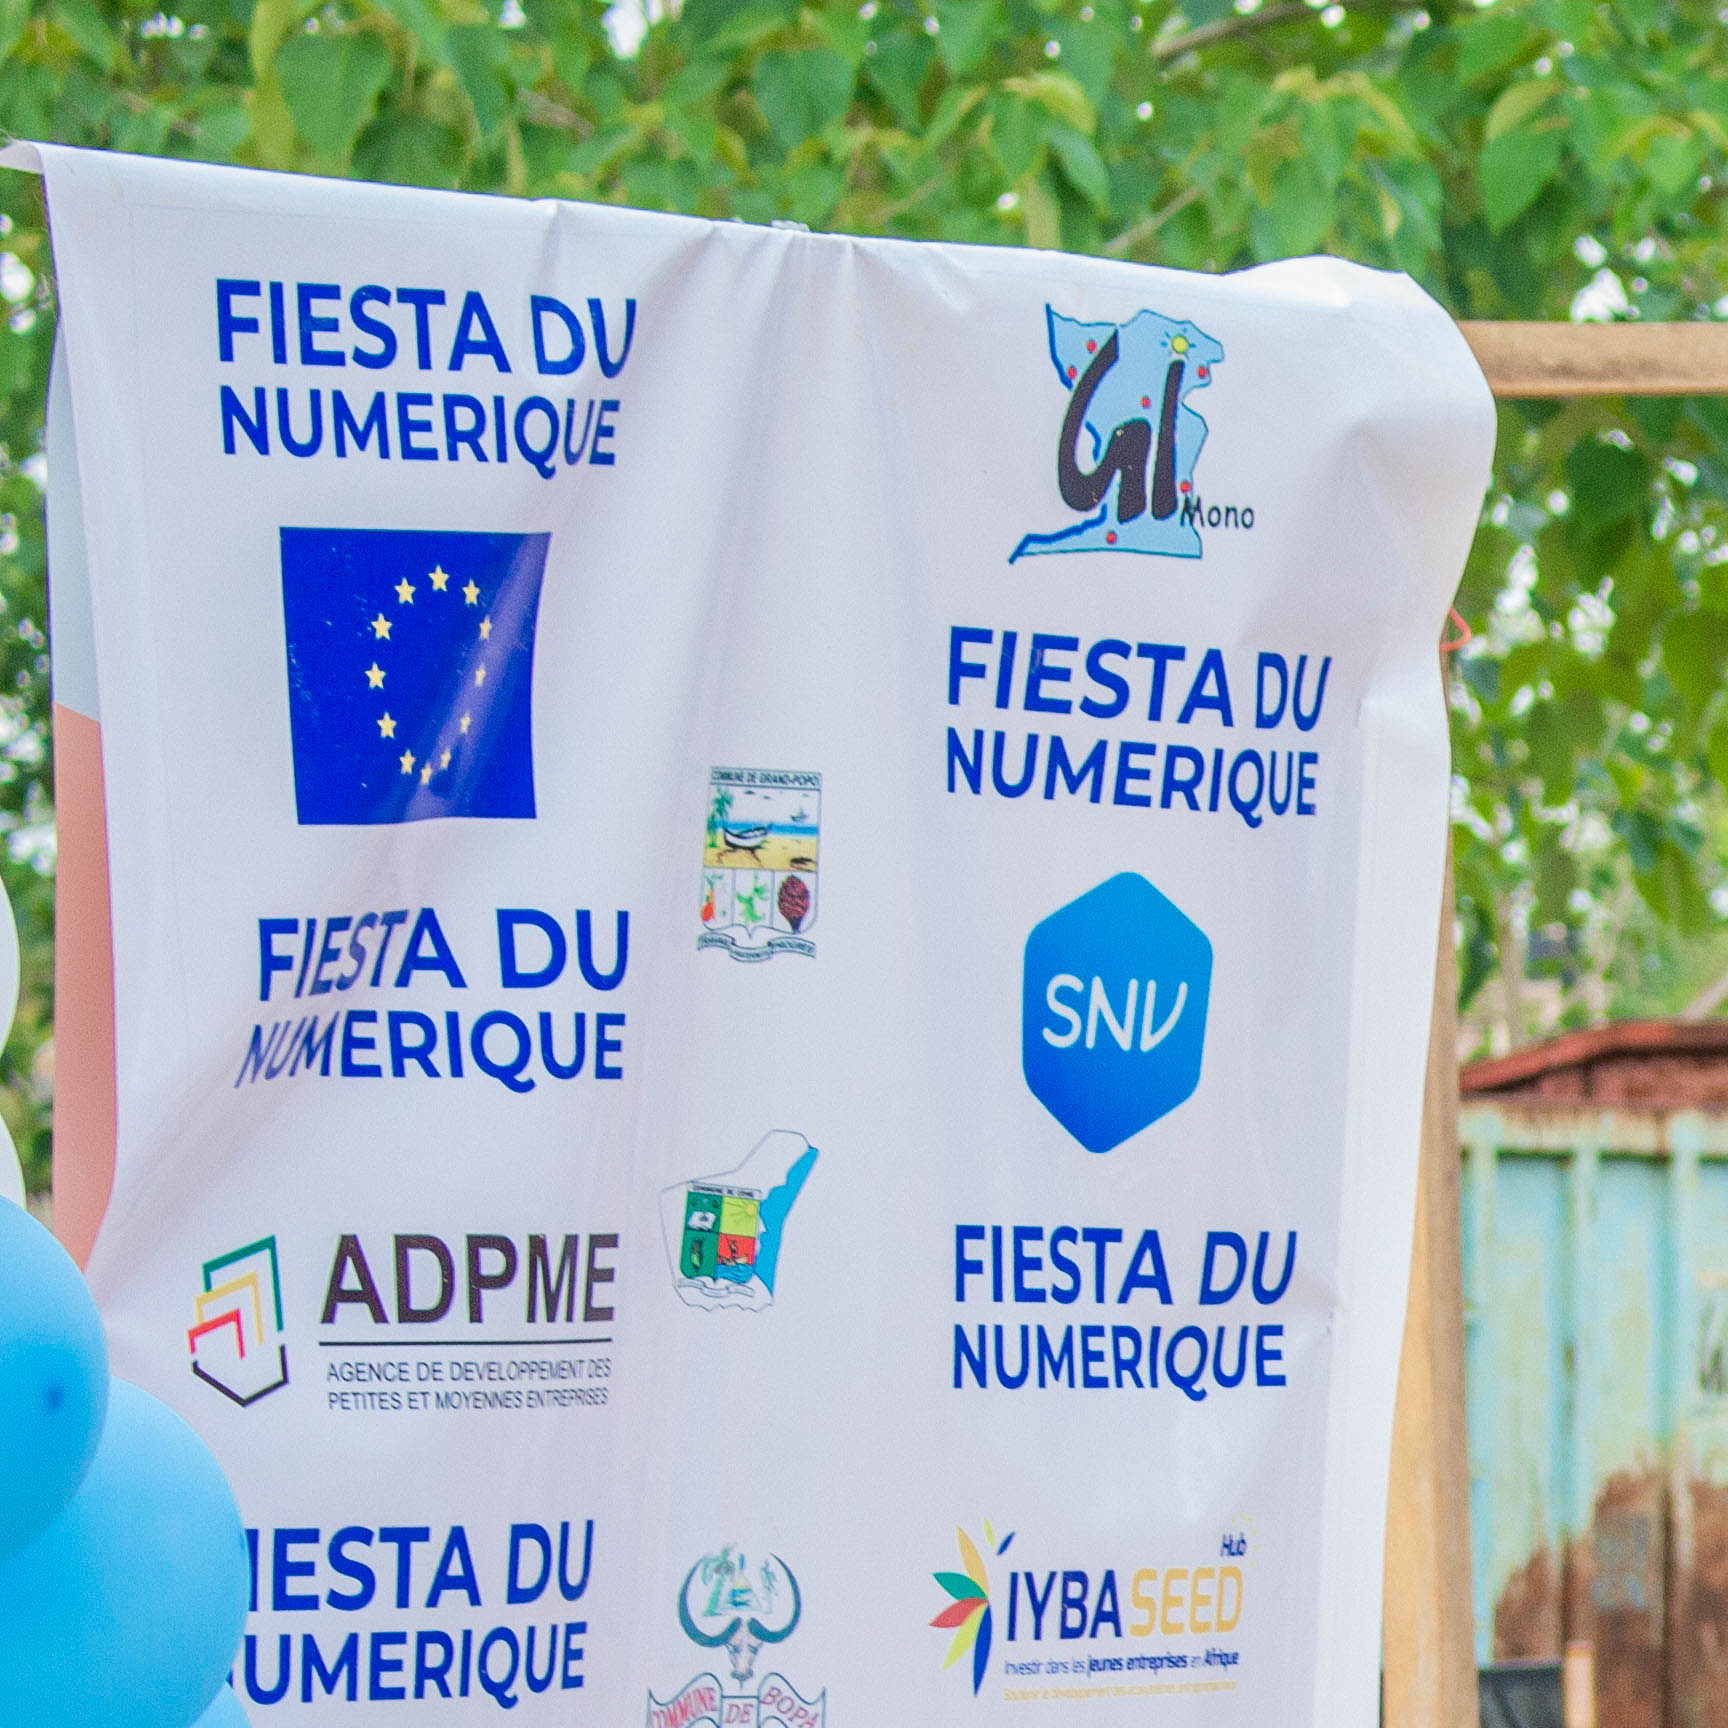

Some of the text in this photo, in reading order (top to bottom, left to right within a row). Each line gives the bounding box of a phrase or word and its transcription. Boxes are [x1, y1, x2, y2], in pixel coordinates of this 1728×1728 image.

[217, 278, 637, 379] FIESTA DU
[219, 385, 620, 479] NUMERIQUE
[1180, 496, 1256, 530] Mono
[948, 626, 1331, 732] FIESTA DU
[947, 727, 1319, 828] NUMERIQUE
[257, 907, 630, 1002] FIESTA DU
[234, 1009, 626, 1093] NUMERIQUE
[1042, 973, 1188, 1053] SNV
[319, 1233, 619, 1325] ADPME
[954, 1224, 1298, 1306] FIESTA DU
[327, 1357, 612, 1383] AGENCE DE DEVELOPPEMENT DES
[328, 1387, 609, 1411] PETITES ET MOYENNES ENTREPRISES
[953, 1324, 1287, 1402] NUMERIQUE
[245, 1519, 594, 1613] IESTA DU
[225, 1621, 588, 1710] UMERIQUE
[724, 1703, 755, 1724] DE
